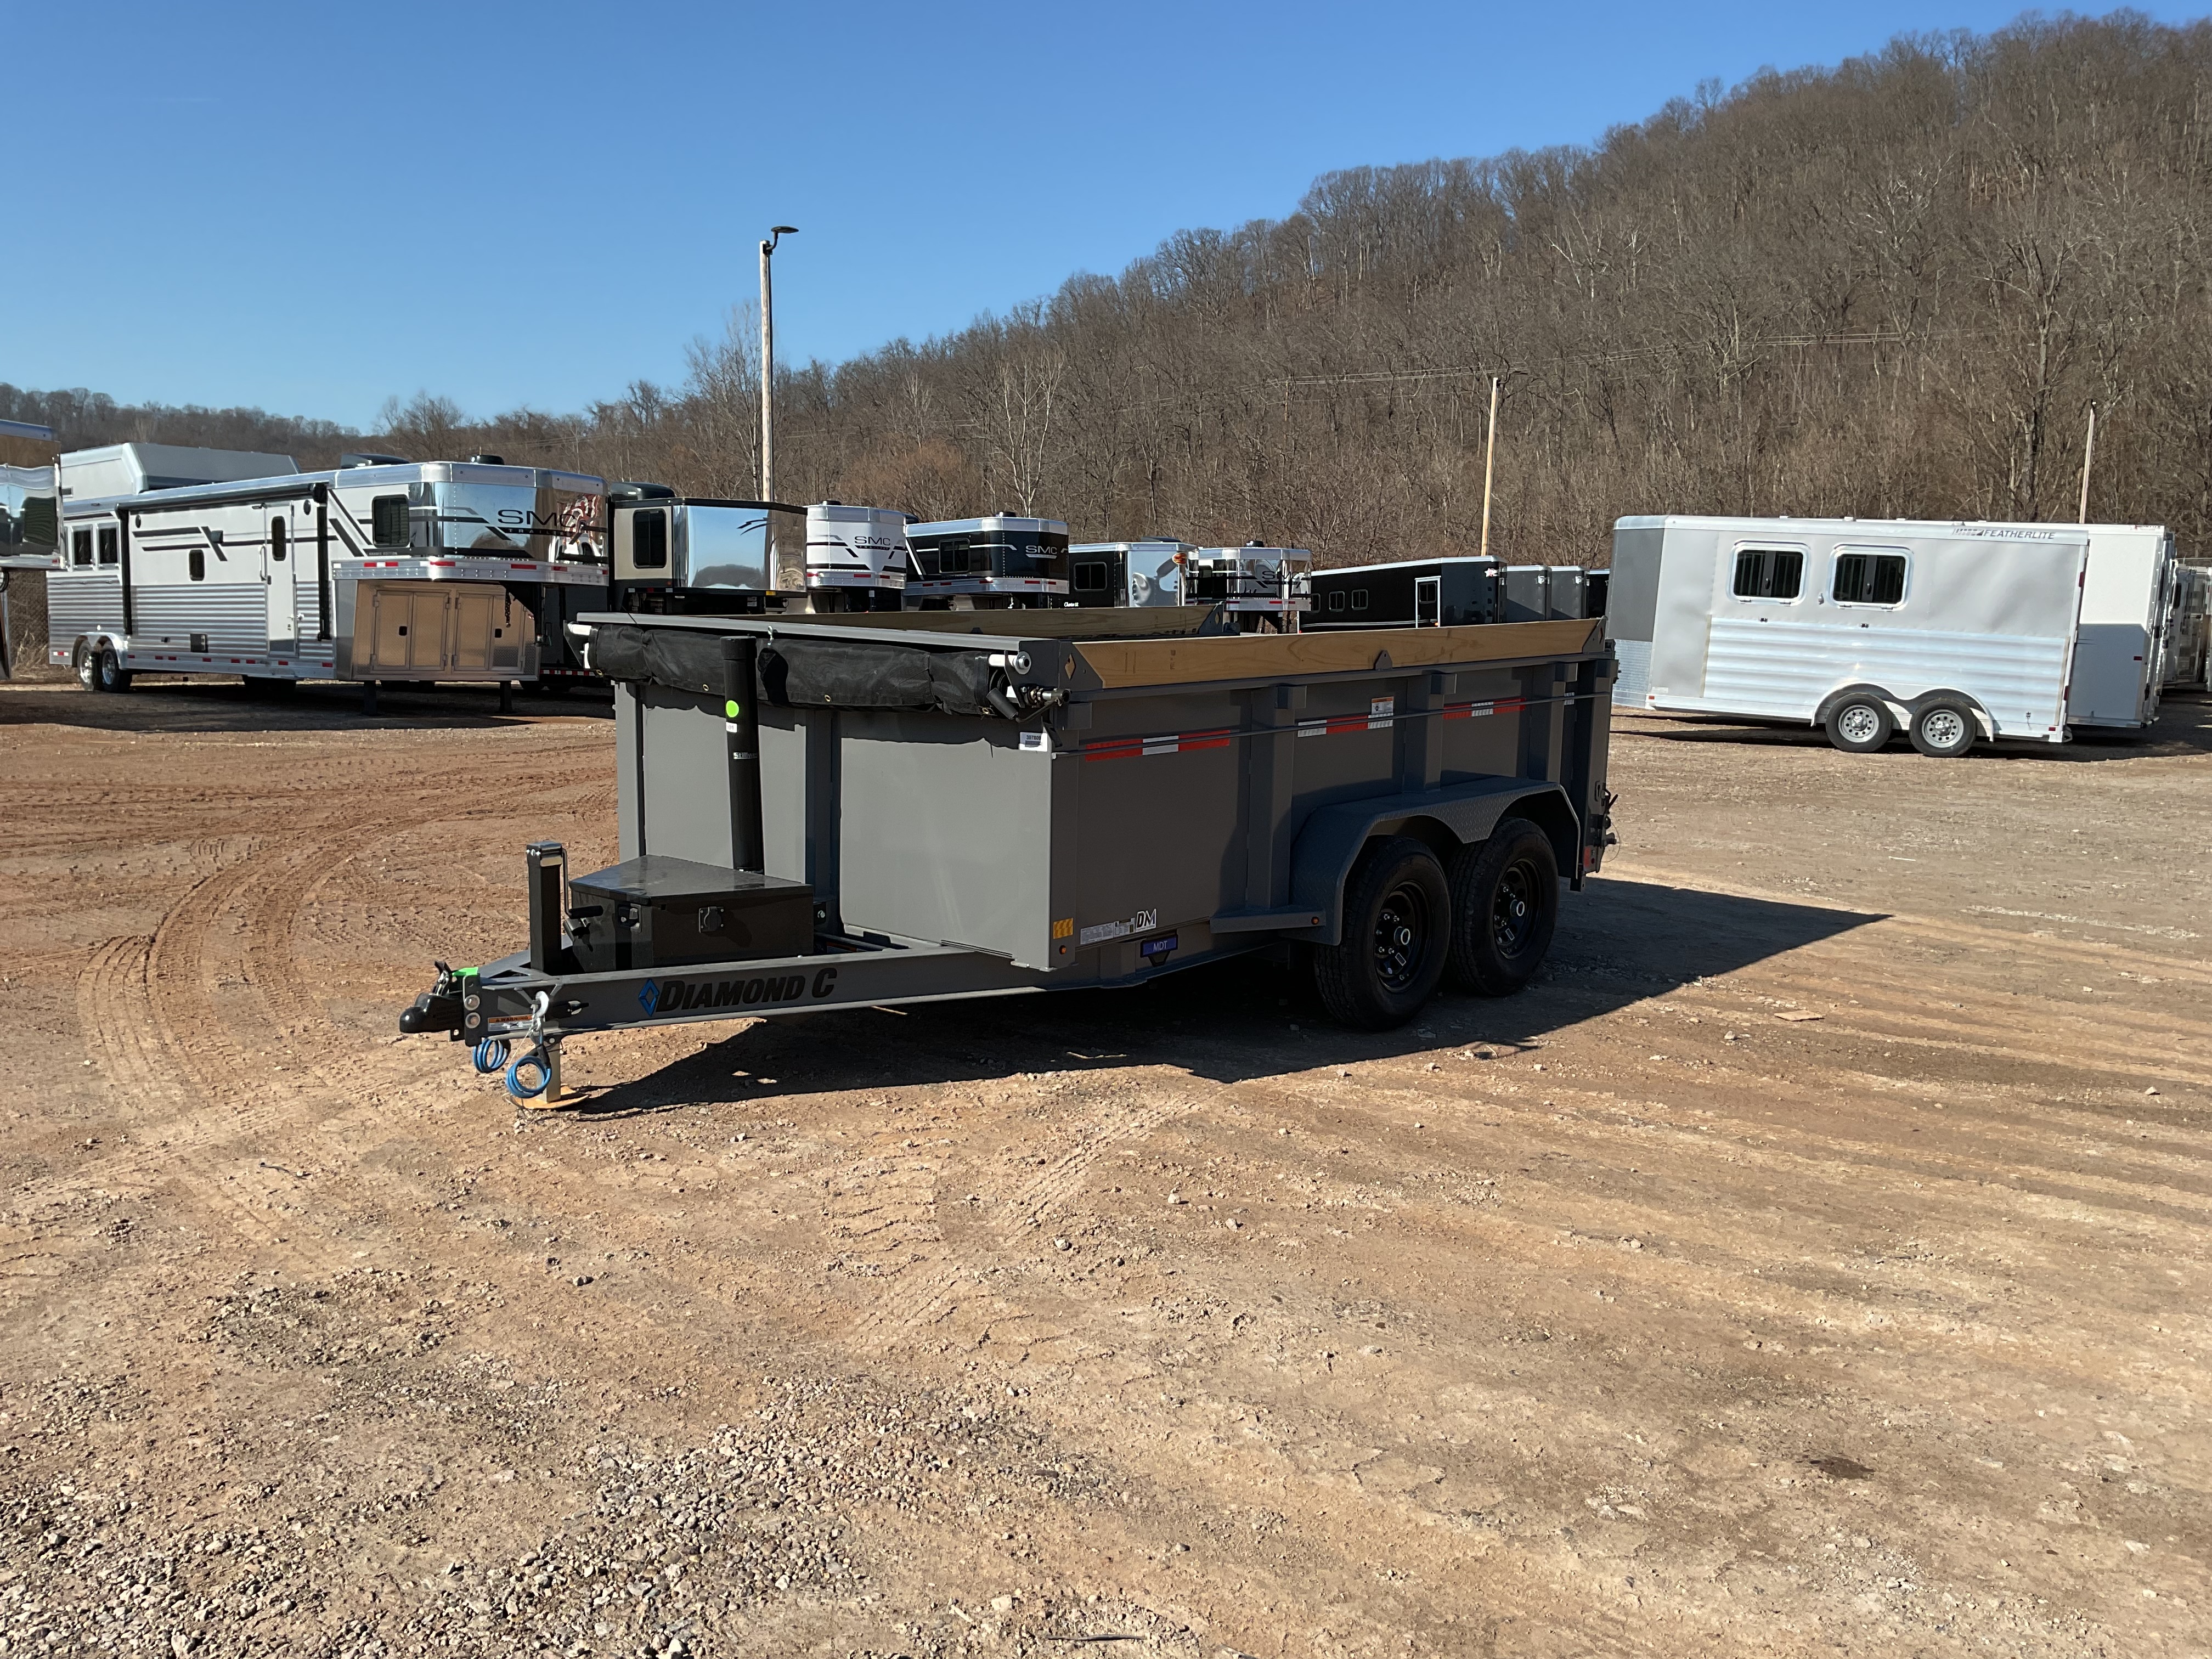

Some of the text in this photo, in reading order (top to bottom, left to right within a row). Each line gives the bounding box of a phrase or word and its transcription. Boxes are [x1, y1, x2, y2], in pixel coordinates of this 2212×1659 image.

[498, 509, 576, 528] SMC
[1984, 529, 2056, 539] FEATHERLITE
[854, 536, 891, 546] SMC
[1025, 545, 1058, 555] SMC
[1262, 571, 1300, 580] SMC
[1136, 909, 1156, 929] DM
[1153, 940, 1168, 952] MDT
[656, 967, 838, 1013] DIAMOND C
